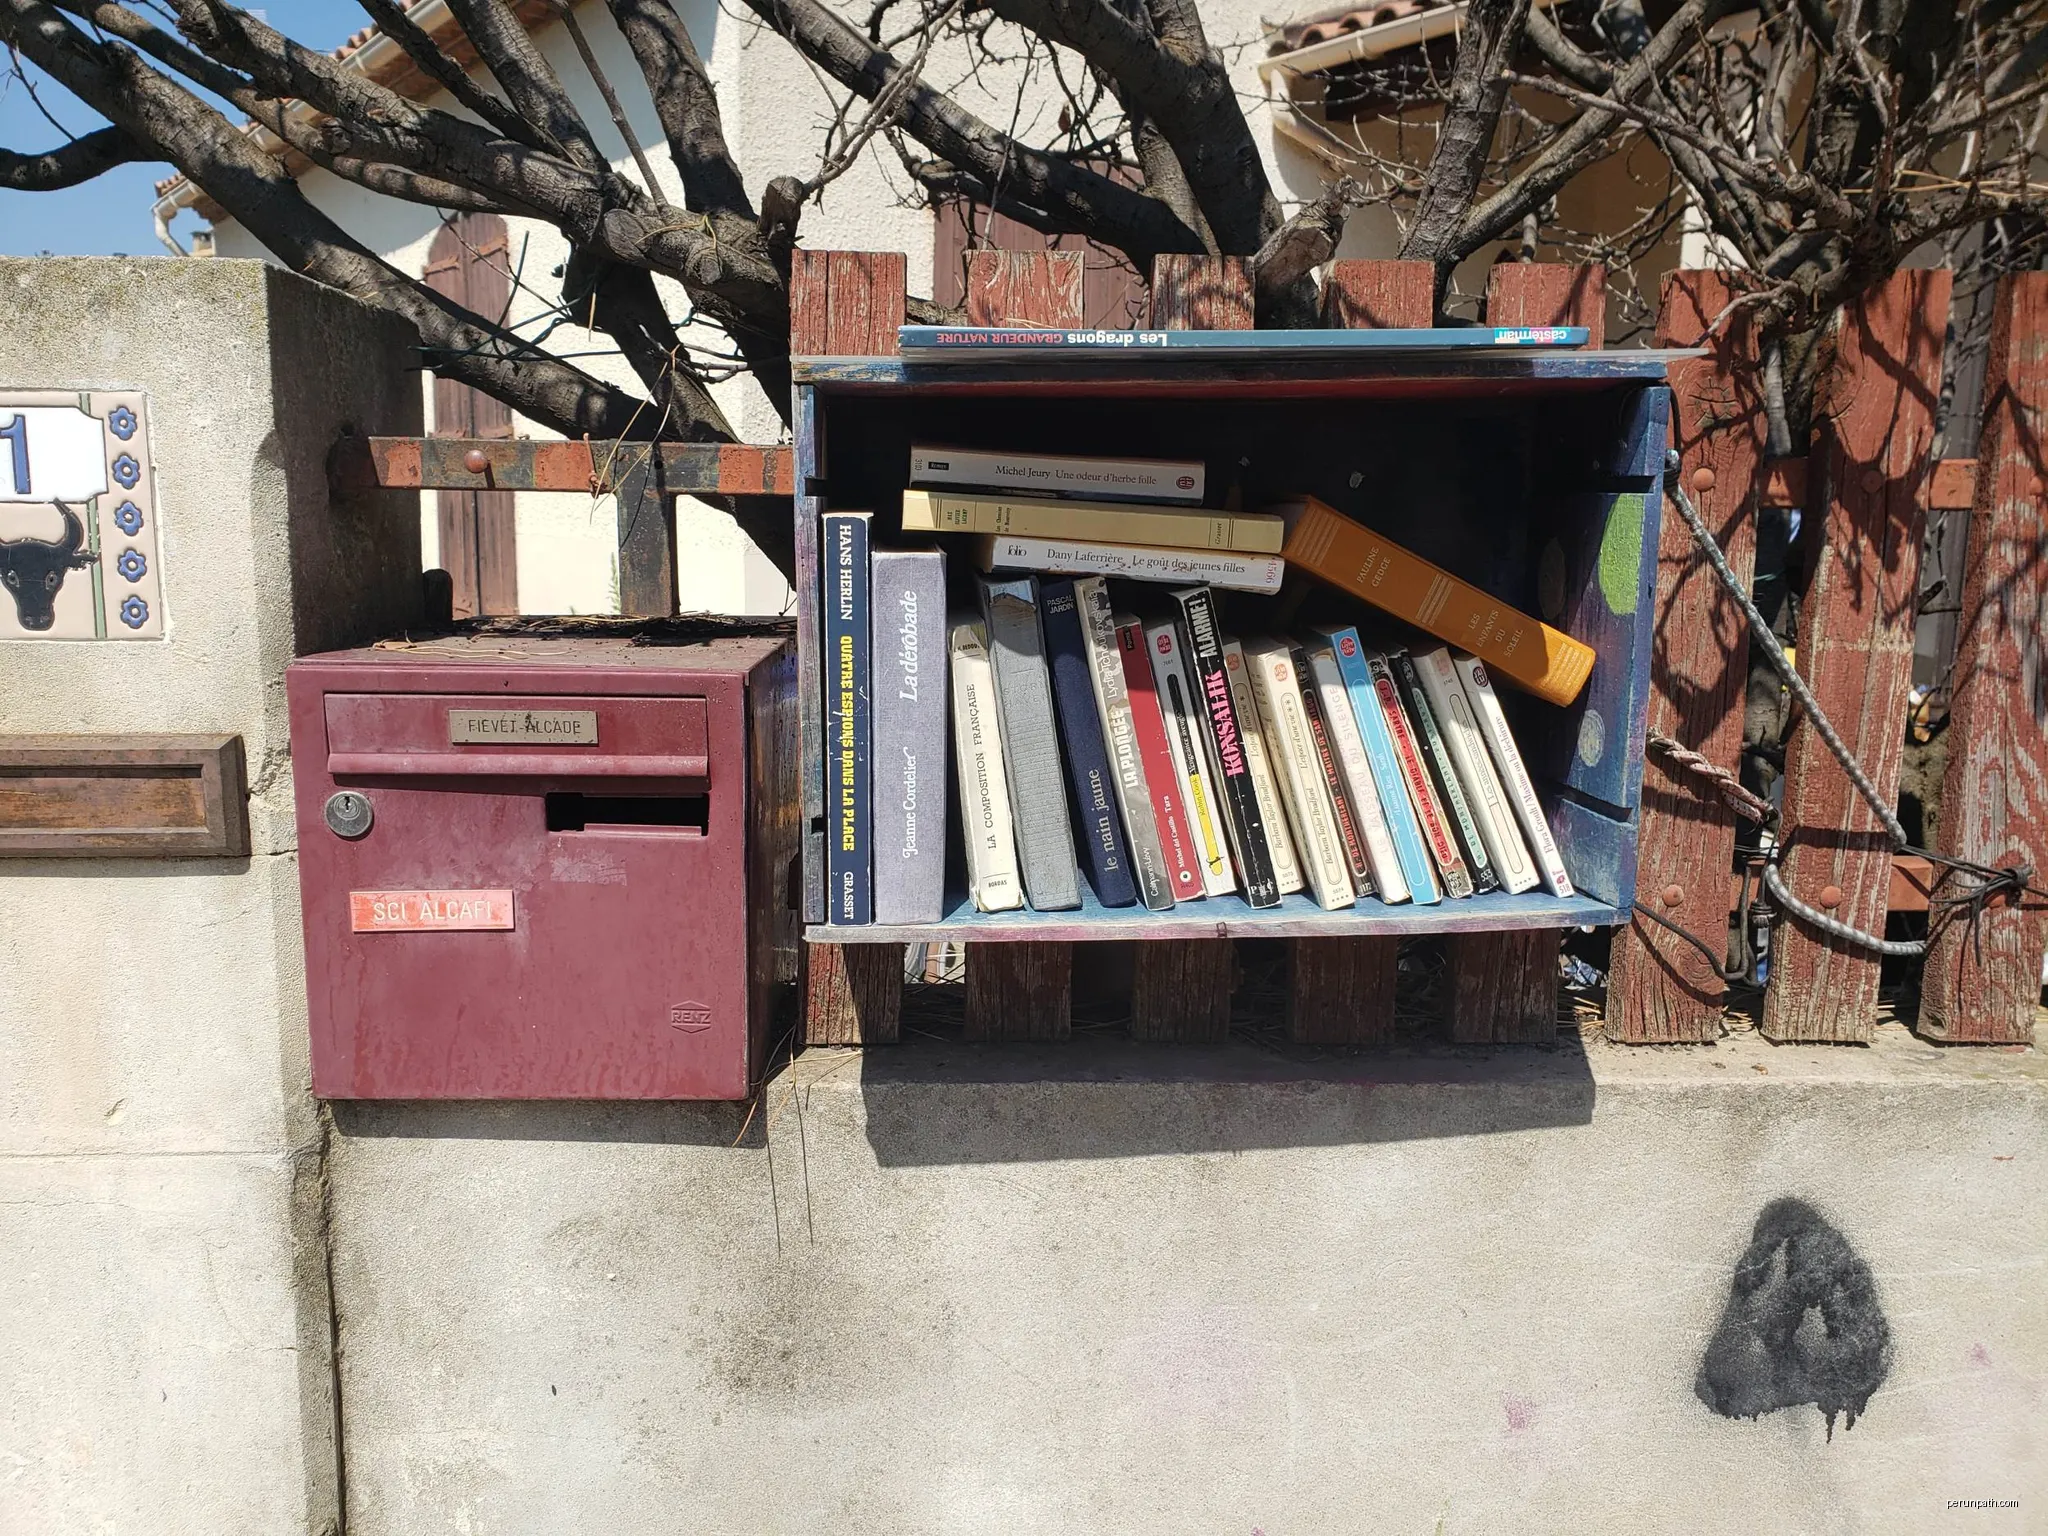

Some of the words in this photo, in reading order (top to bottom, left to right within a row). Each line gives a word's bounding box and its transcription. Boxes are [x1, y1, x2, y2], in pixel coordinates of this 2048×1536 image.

[936, 333, 988, 343] NATURE
[992, 333, 1063, 344] GRANDEUR
[1067, 331, 1133, 346] dragons
[1139, 332, 1168, 347] Les
[1498, 330, 1567, 342] casterman
[0, 414, 31, 494] 1
[995, 465, 1026, 476] Michel
[1028, 468, 1050, 479] Jeury
[1055, 470, 1074, 479] Une
[1076, 471, 1101, 481] odeur
[1103, 473, 1136, 484] d'herbe
[1138, 475, 1157, 485] folle
[839, 524, 852, 565] HANS
[1007, 545, 1027, 557] folio
[1047, 548, 1072, 560] Dany
[1075, 550, 1123, 563] Laferrière
[1132, 555, 1145, 567] Le
[1147, 557, 1169, 568] goût
[1172, 558, 1188, 568] des
[1188, 560, 1220, 571] jeunes
[1223, 562, 1245, 573] filles
[1355, 546, 1379, 583] PAULINE
[1370, 556, 1391, 588] GEDGE
[840, 569, 853, 620] HERLIN
[1046, 595, 1074, 606] PASCAL
[1050, 602, 1074, 614] JARDIN
[900, 590, 918, 675] dérobade
[1188, 597, 1217, 657] ALARME!
[1466, 612, 1481, 629] LES
[1474, 608, 1500, 647] ENFANTS
[1494, 628, 1506, 642] DU
[1502, 626, 1523, 657] SOLEIL
[840, 635, 854, 688] QUATRE
[900, 677, 918, 702] La
[1104, 670, 1117, 698] Lydia
[841, 691, 854, 747] ESPIONS
[966, 683, 983, 745] FRANÇAISE
[1204, 669, 1244, 777] KONSALIK
[1387, 710, 1404, 739] SARTRE
[1494, 715, 1514, 754] déchirure
[841, 750, 855, 785] DANS
[1184, 737, 1196, 773] Vengeance
[1295, 743, 1308, 770] L'espace
[1509, 752, 1518, 762] la
[1514, 760, 1522, 771] ou
[903, 747, 916, 810] Cordelier
[975, 752, 993, 828] COMPOSITION
[1087, 768, 1109, 814] jaune
[1122, 769, 1139, 788] LA
[1408, 767, 1424, 793] DIABLE
[1516, 771, 1534, 803] Maxime
[842, 788, 855, 806] LA
[1162, 795, 1172, 813] Tara
[1305, 786, 1321, 817] Bradford
[1485, 785, 1494, 800] Les
[842, 809, 855, 851] PLACE
[1316, 816, 1327, 836] Taylor
[1528, 806, 1545, 832] Groult
[903, 812, 918, 858] Jeanne
[986, 834, 996, 849] LA
[1097, 815, 1115, 852] nain
[1271, 821, 1284, 850] Barbara
[1540, 831, 1554, 854] Flora
[1105, 855, 1119, 872] le
[1321, 836, 1334, 865] Barbara
[1481, 869, 1493, 882] 553
[843, 871, 854, 919] GRASSET
[373, 902, 406, 921] SCI
[419, 901, 491, 920] ALCAFI
[671, 1009, 711, 1024] RENZ
